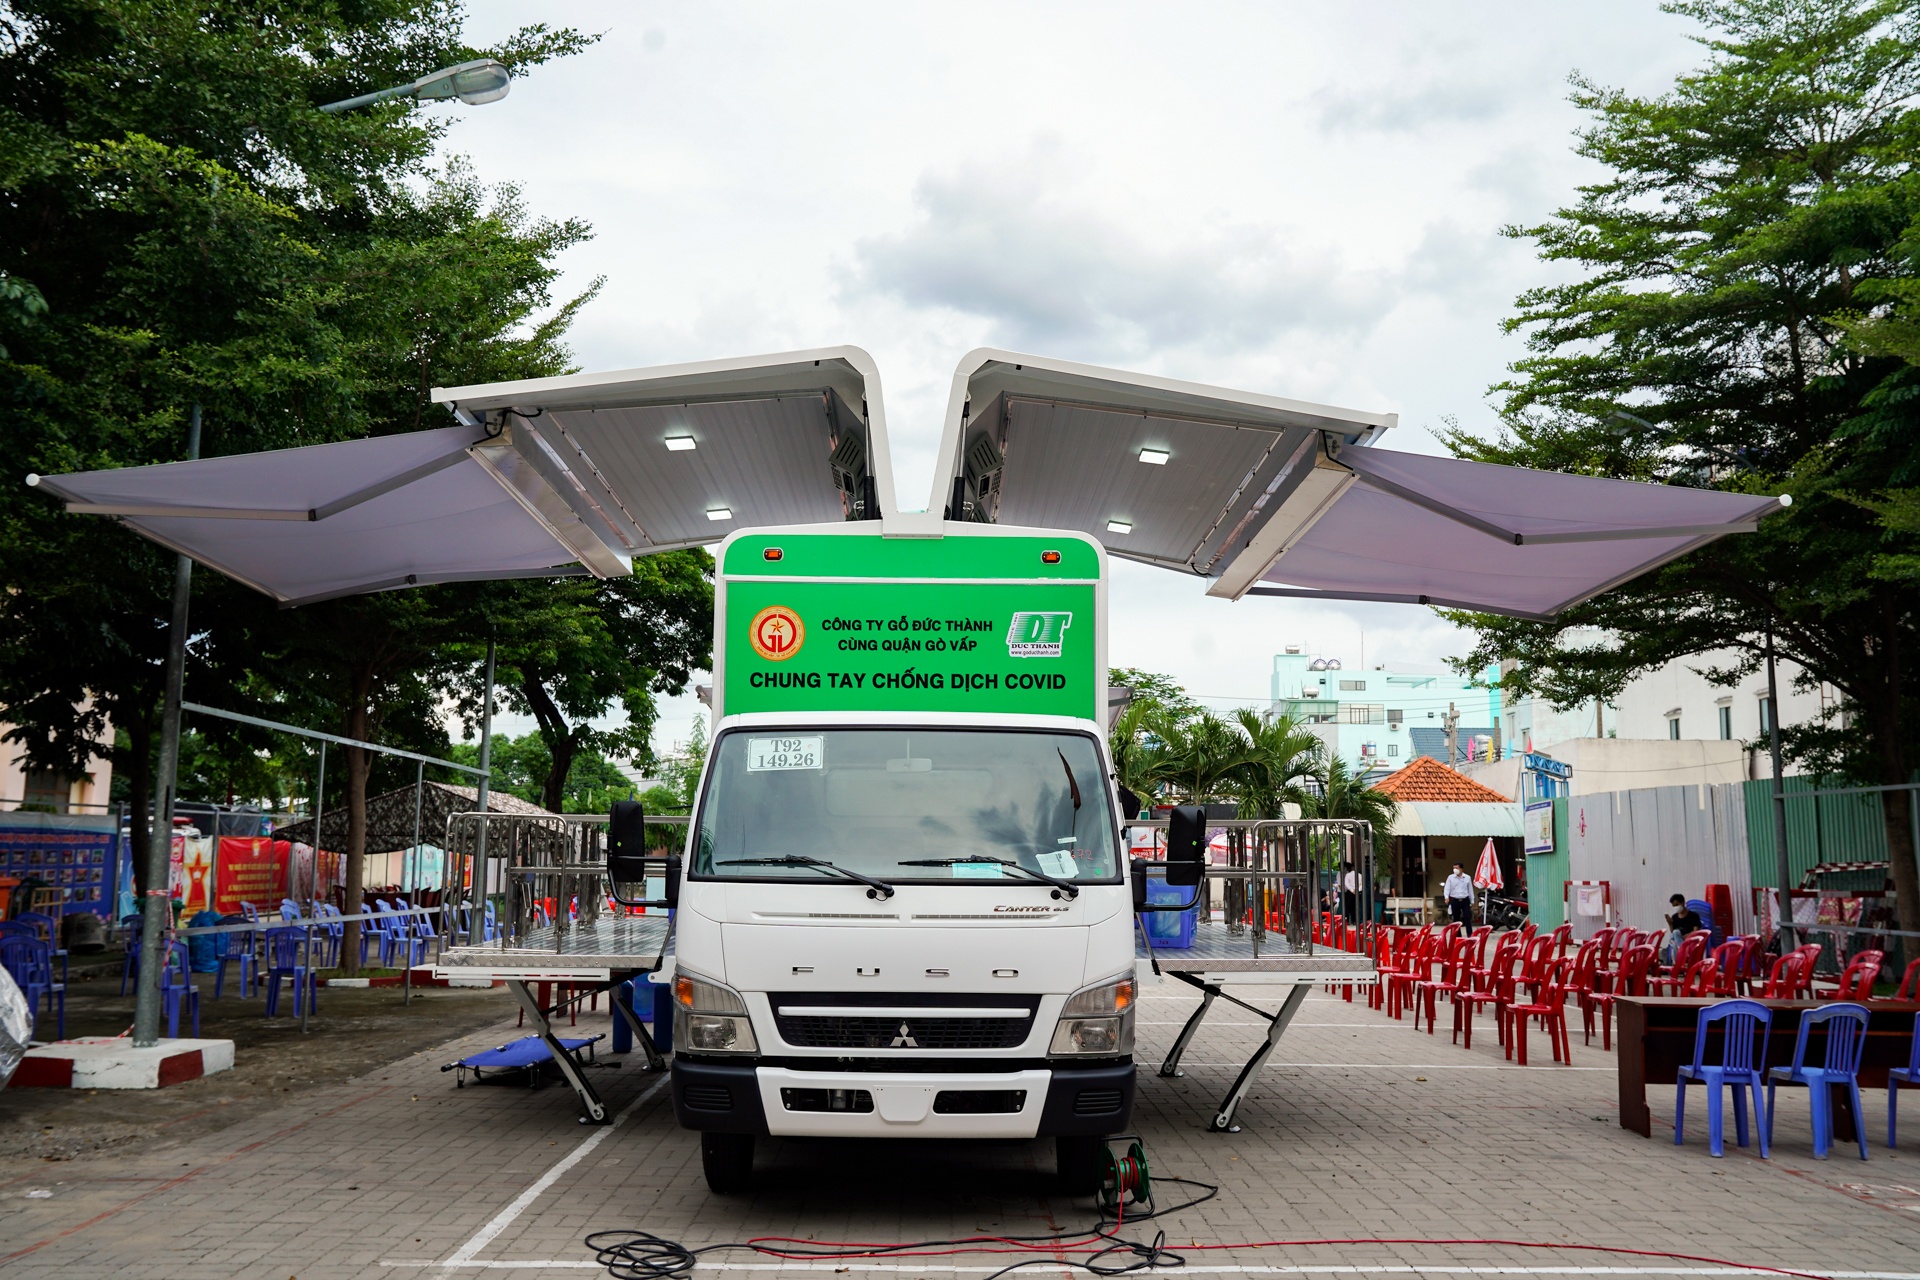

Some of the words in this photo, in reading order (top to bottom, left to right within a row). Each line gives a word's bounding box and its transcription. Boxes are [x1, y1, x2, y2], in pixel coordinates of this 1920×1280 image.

[822, 617, 861, 630] CÔNG
[866, 620, 883, 630] TY
[888, 616, 908, 631] GỖ
[912, 618, 941, 631] ĐỨC
[946, 618, 992, 631] THÀNH
[838, 637, 877, 650] CÙNG
[882, 638, 920, 653] QUẬN
[926, 638, 946, 651] GÒ
[950, 636, 977, 651] VẤP
[750, 672, 820, 688] CHUNG
[828, 673, 865, 688] TAY
[873, 667, 943, 688] CHỐNG
[952, 674, 997, 692] DỊCH
[1005, 674, 1065, 689] COVID
[770, 739, 802, 753] T92
[758, 753, 815, 768] 149.26
[792, 966, 1019, 978] FUSO
